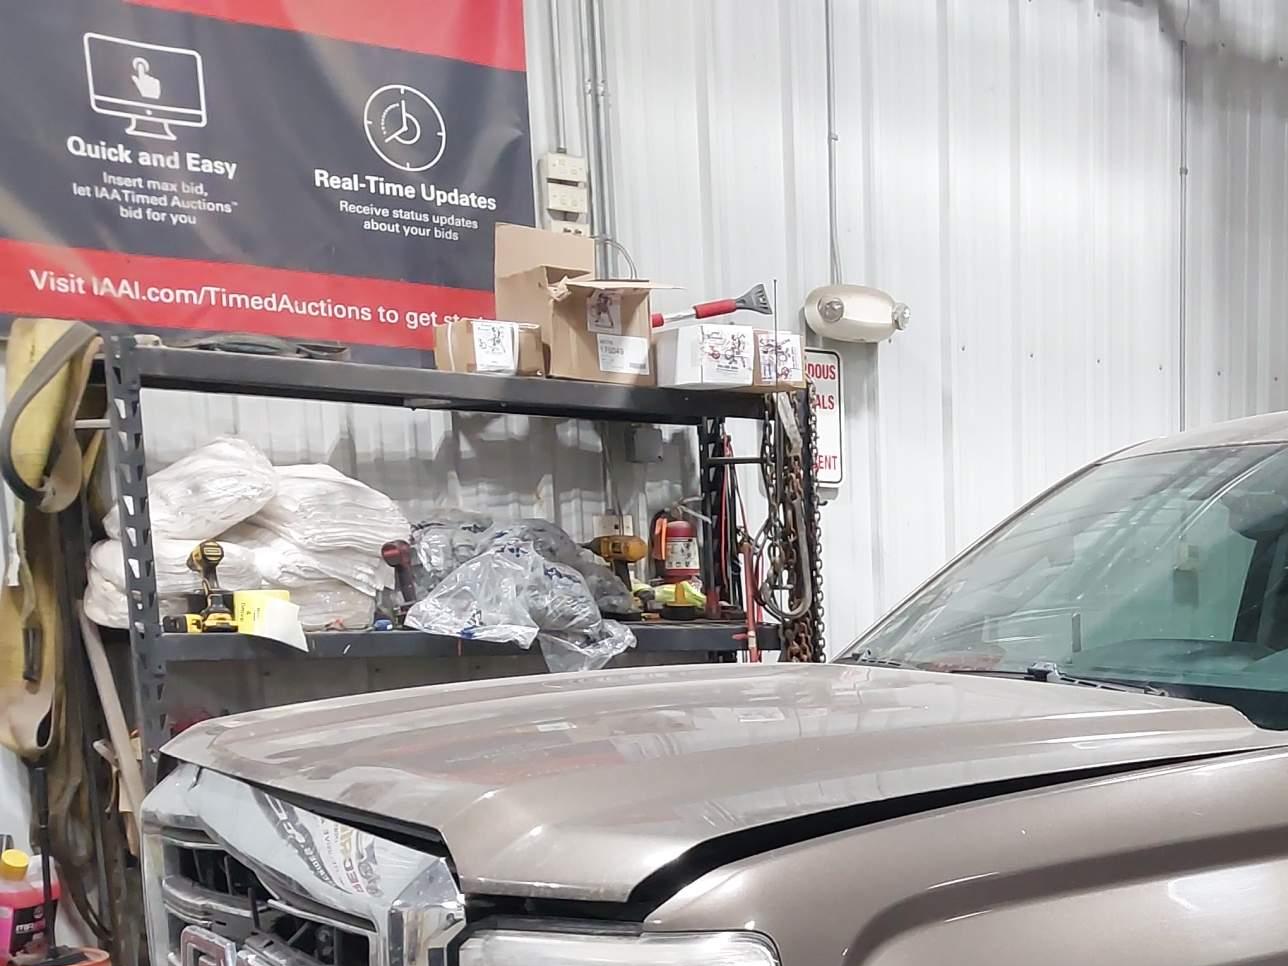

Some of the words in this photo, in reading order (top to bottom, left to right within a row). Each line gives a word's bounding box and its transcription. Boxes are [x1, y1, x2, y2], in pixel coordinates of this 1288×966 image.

[67, 136, 132, 164] Quick
[138, 151, 180, 169] and
[186, 152, 237, 179] Easy
[73, 183, 91, 197] let
[122, 187, 168, 207] Timed
[103, 171, 144, 189] Insert
[147, 179, 178, 192] max
[182, 181, 208, 196] bid,
[314, 169, 416, 199] Real-Time
[421, 183, 497, 211] Updates
[120, 206, 142, 220] bid
[146, 208, 167, 221] for
[170, 212, 197, 225] you
[340, 200, 389, 218] Receive
[392, 208, 429, 223] status
[432, 213, 479, 229] updates
[363, 219, 400, 234] about
[403, 224, 431, 237] your
[434, 226, 459, 241] bids
[29, 269, 86, 295] Visit
[92, 276, 372, 322] IAAI.com/TimedAuctions
[377, 305, 399, 324] to
[406, 310, 438, 329] get
[805, 363, 836, 381] DOUS
